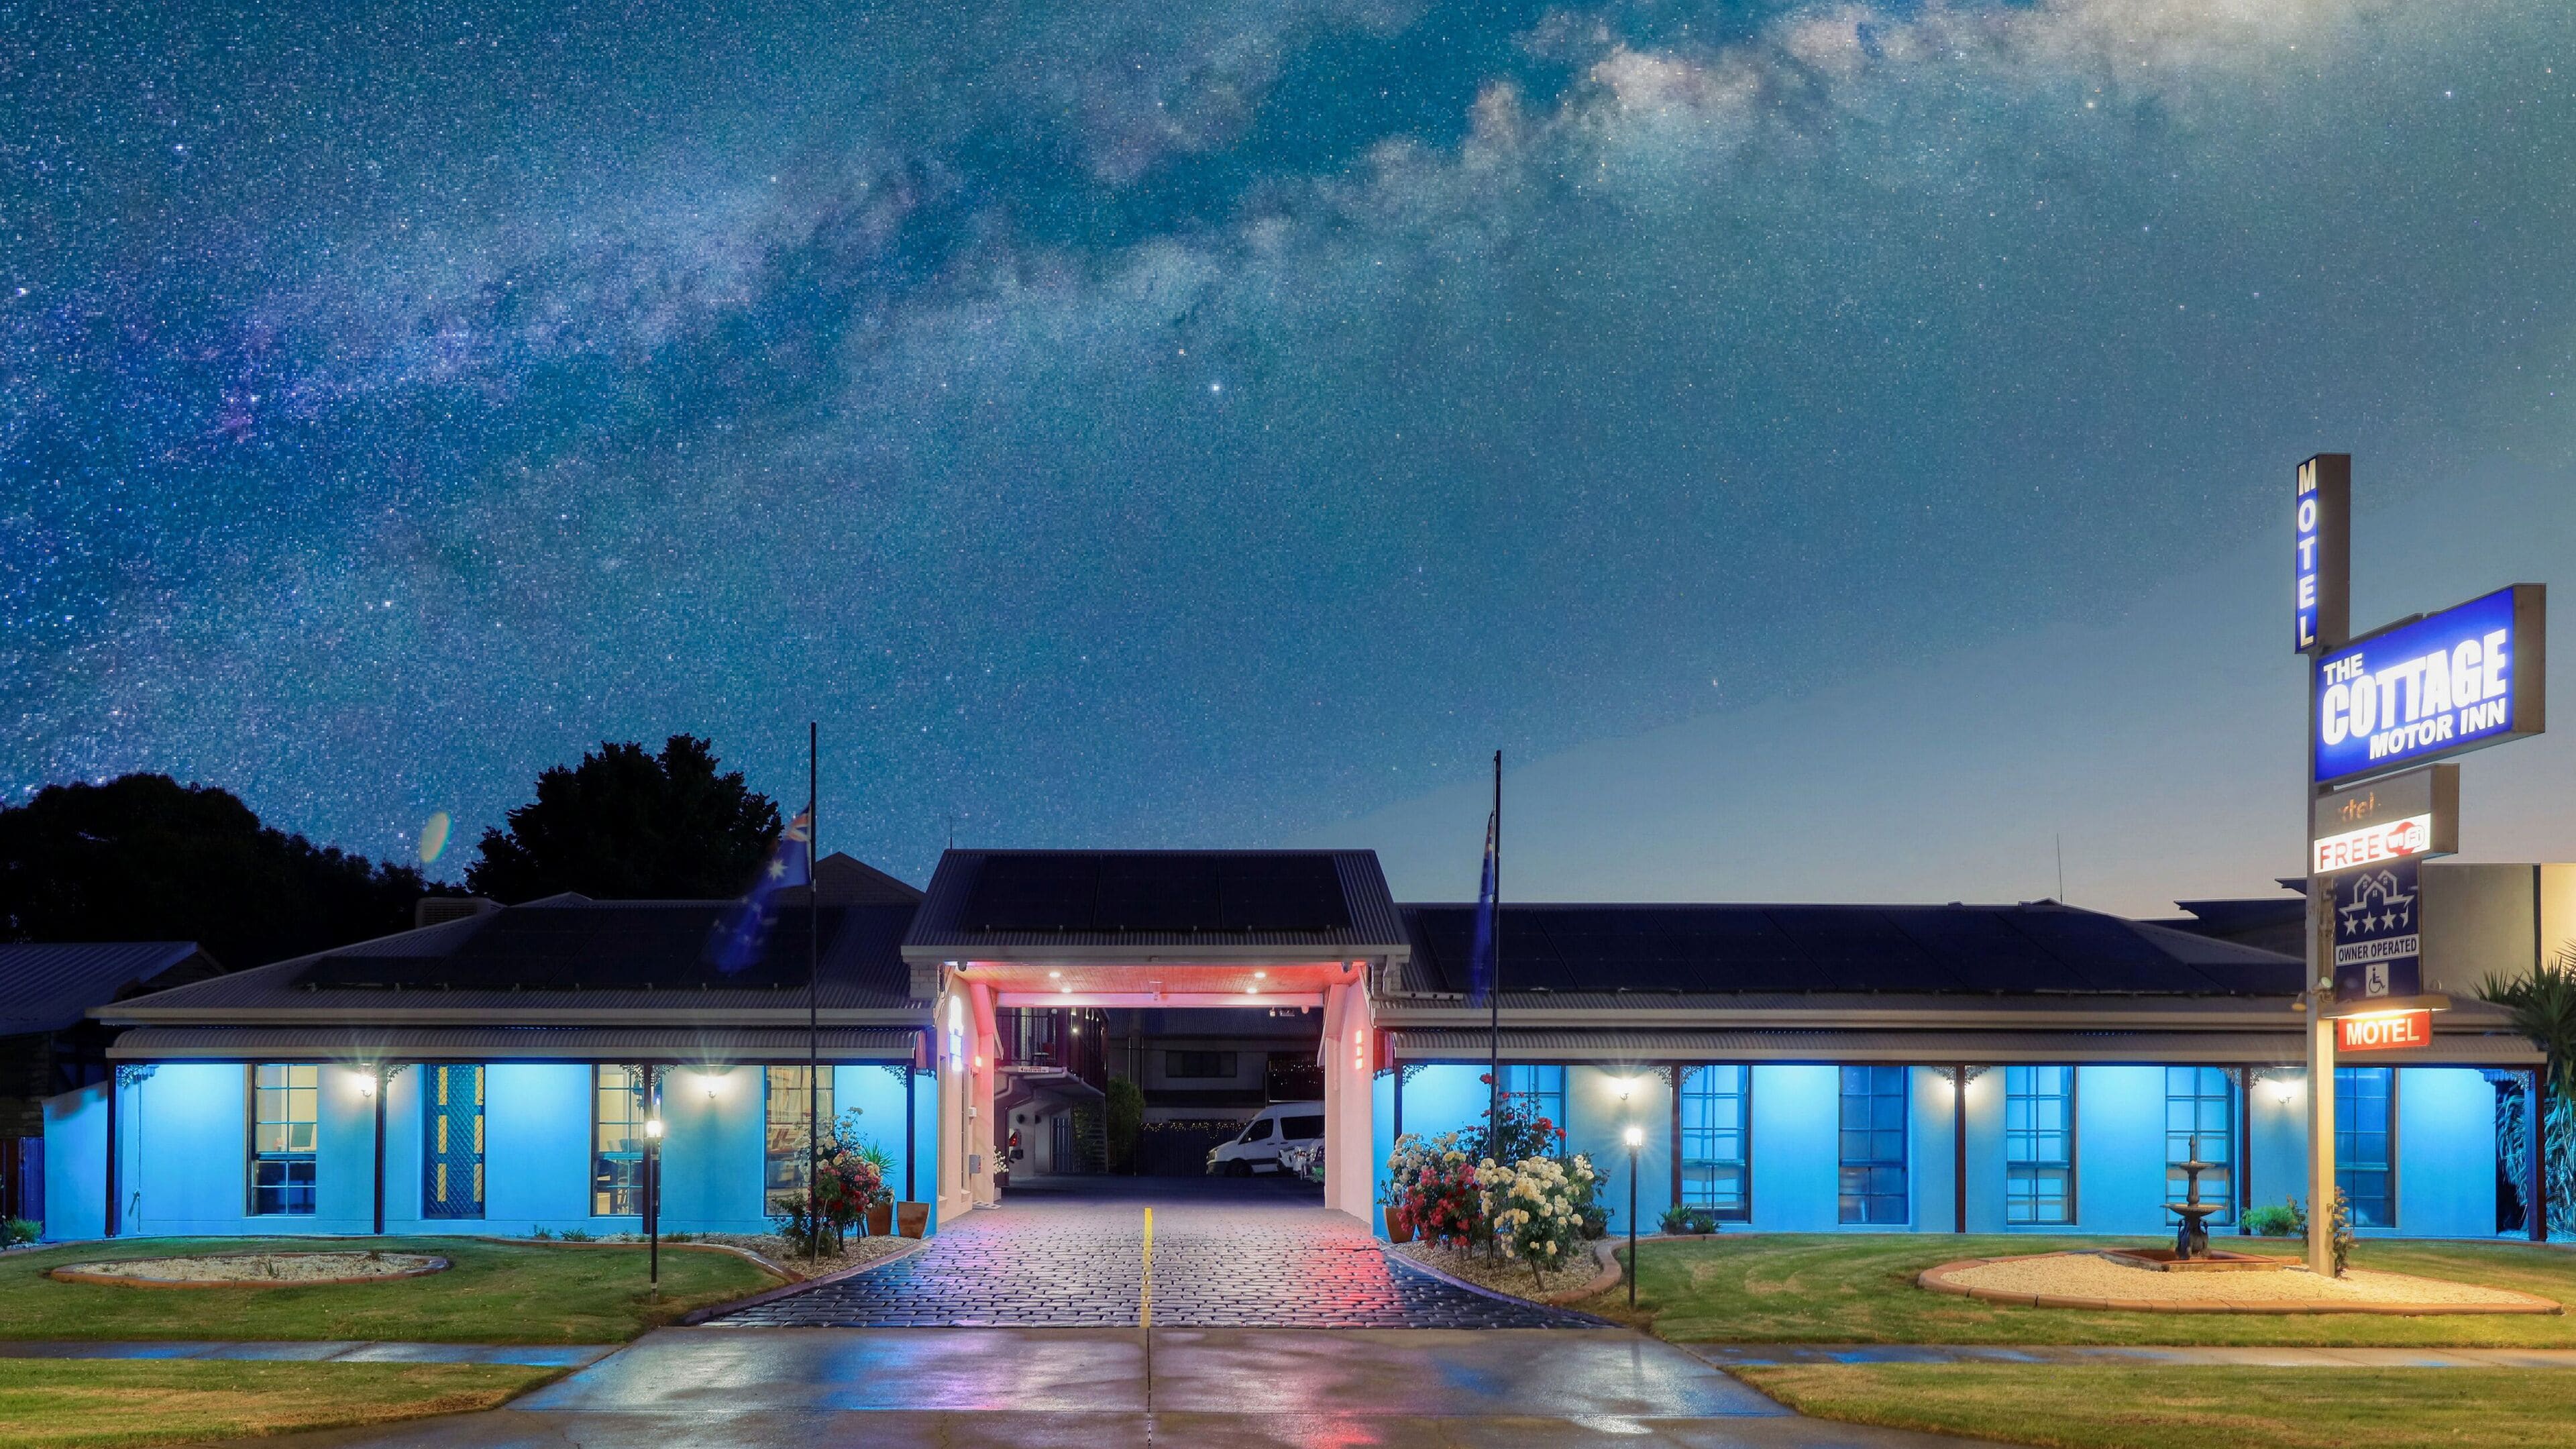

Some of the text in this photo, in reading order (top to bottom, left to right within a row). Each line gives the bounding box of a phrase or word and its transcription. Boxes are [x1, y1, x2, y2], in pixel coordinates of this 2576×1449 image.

[2298, 458, 2316, 647] MOTEL
[2323, 653, 2364, 686] THE
[2322, 629, 2507, 746] COTTAGE
[2369, 697, 2506, 760] MOTOR INN
[2320, 834, 2380, 869] FREE
[2339, 937, 2417, 961] OWNER OPERATED
[2346, 1018, 2420, 1046] MOTEL
